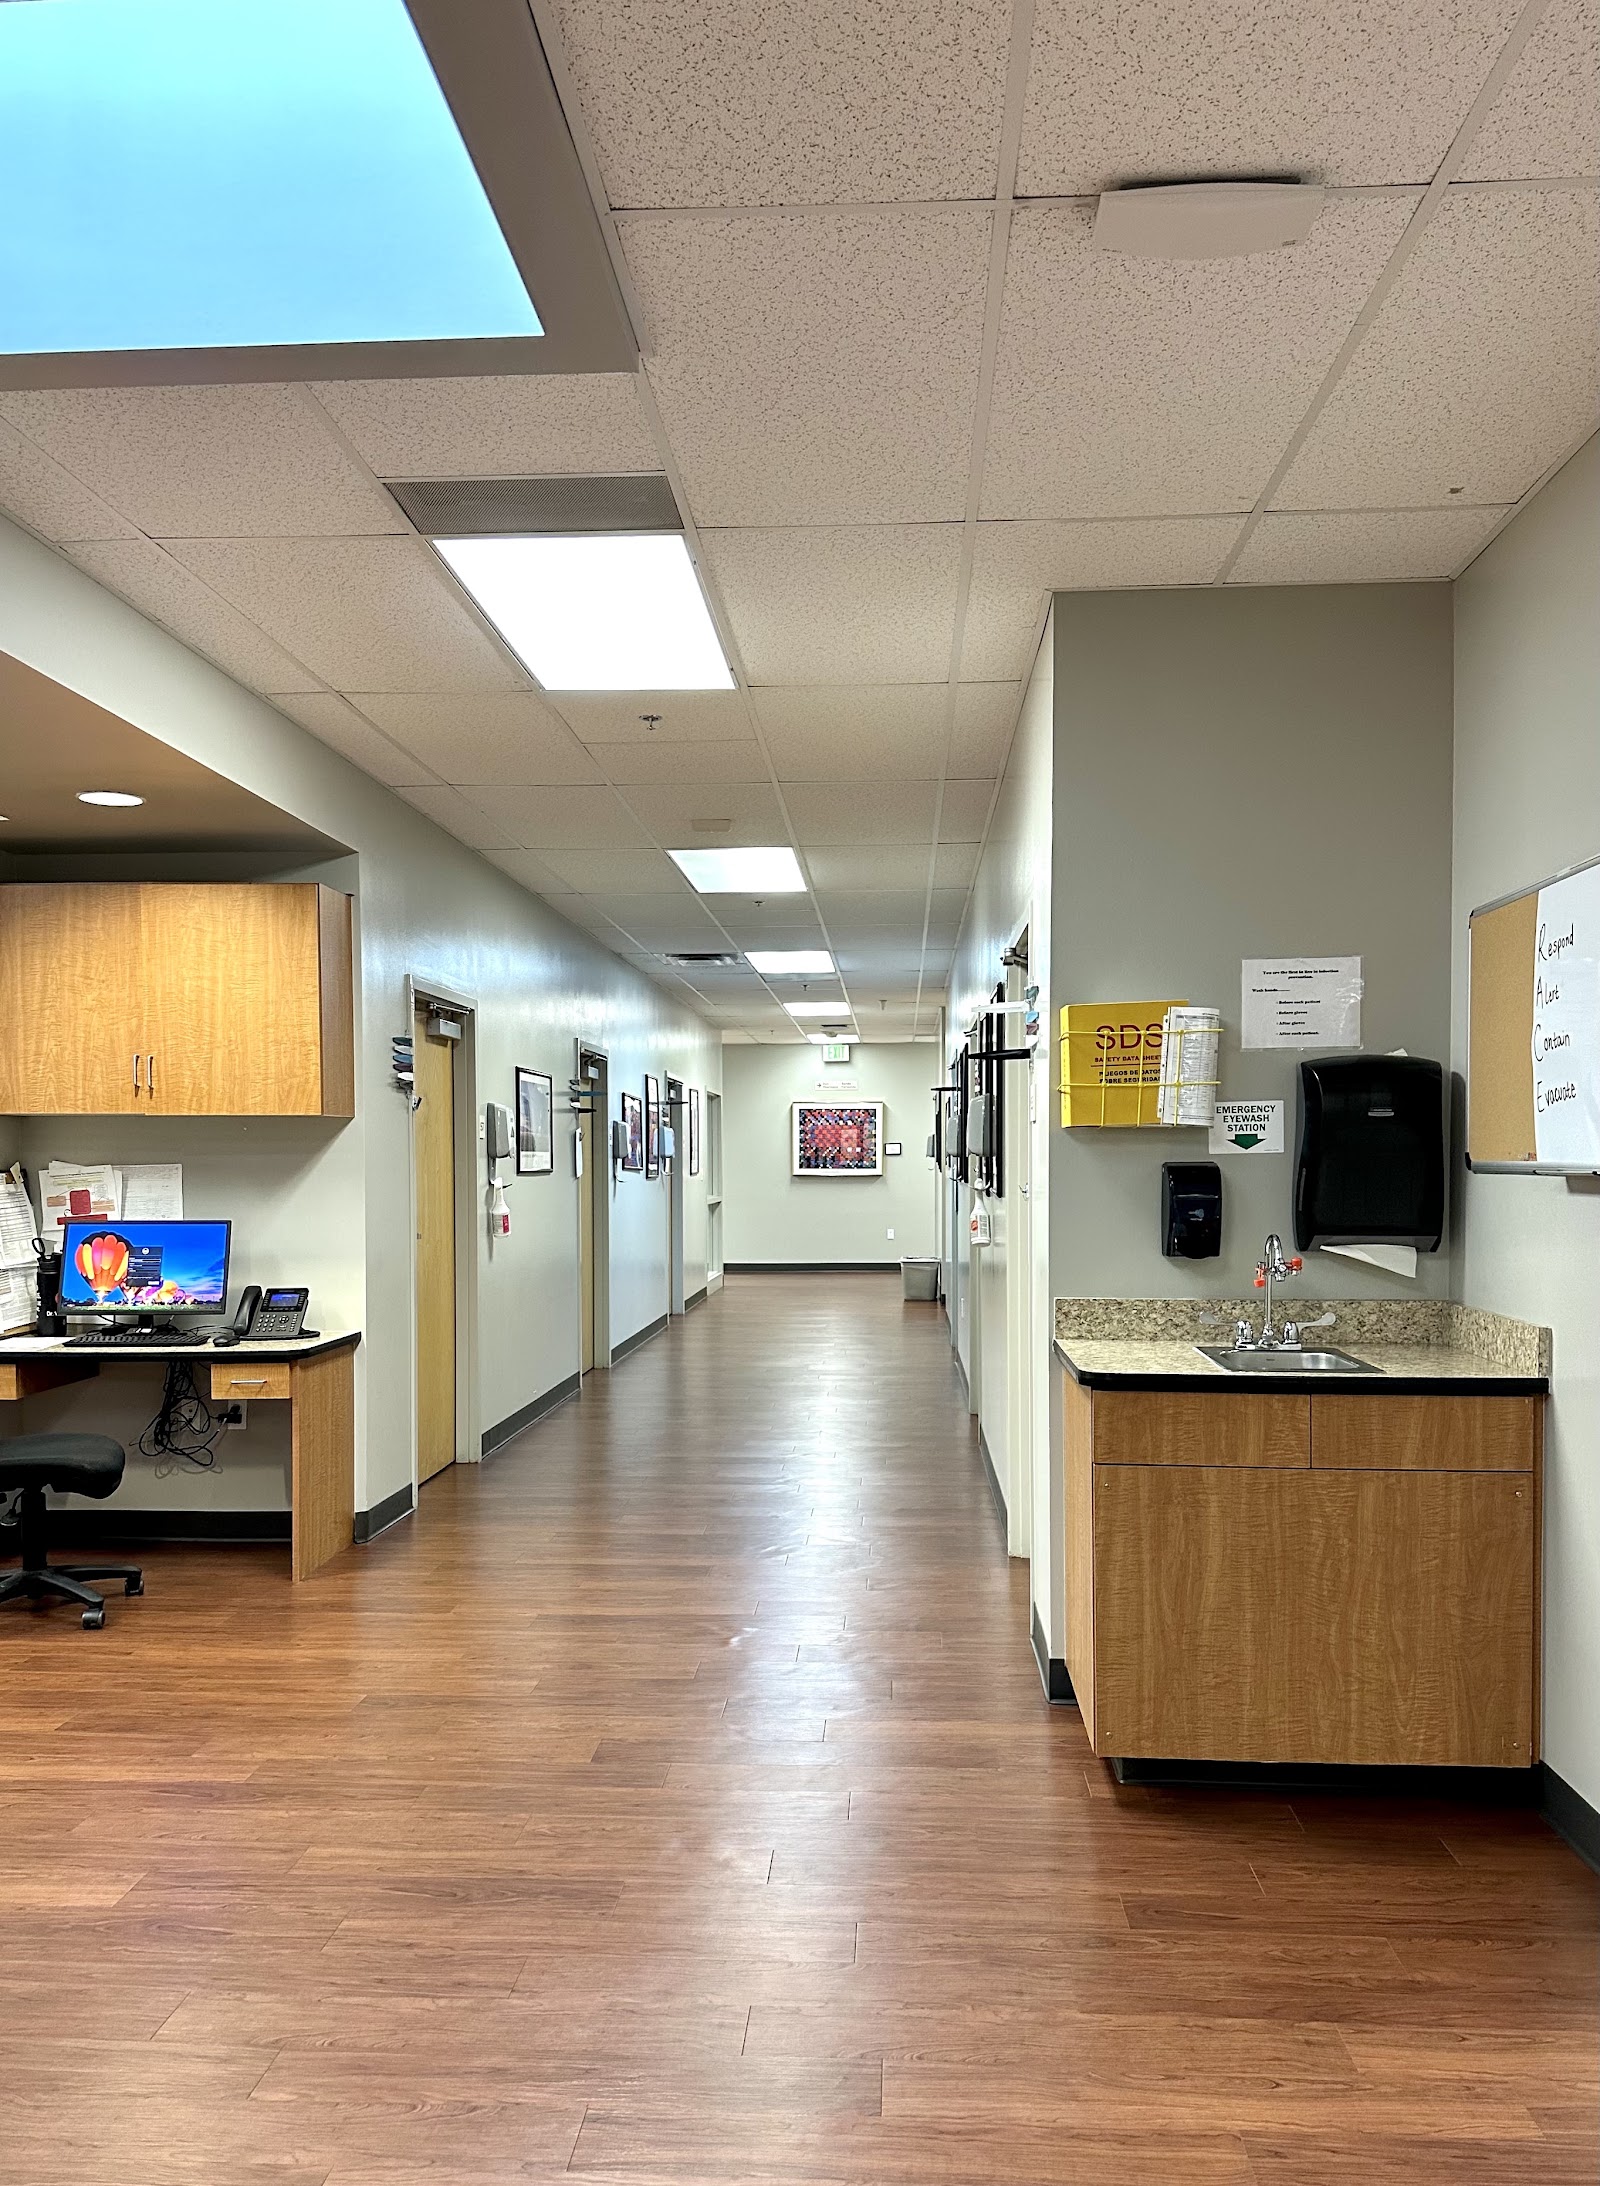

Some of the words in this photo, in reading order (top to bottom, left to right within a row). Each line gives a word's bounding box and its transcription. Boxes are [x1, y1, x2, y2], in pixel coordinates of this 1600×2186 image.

[1536, 976, 1560, 1009] Alert
[1095, 1023, 1163, 1050] SDS
[1534, 1023, 1570, 1062] Contain
[828, 1046, 845, 1059] EXIT
[1216, 1105, 1276, 1114] EMERGENCY
[1223, 1114, 1270, 1123] EYEWASH
[1227, 1123, 1266, 1132] STATION
